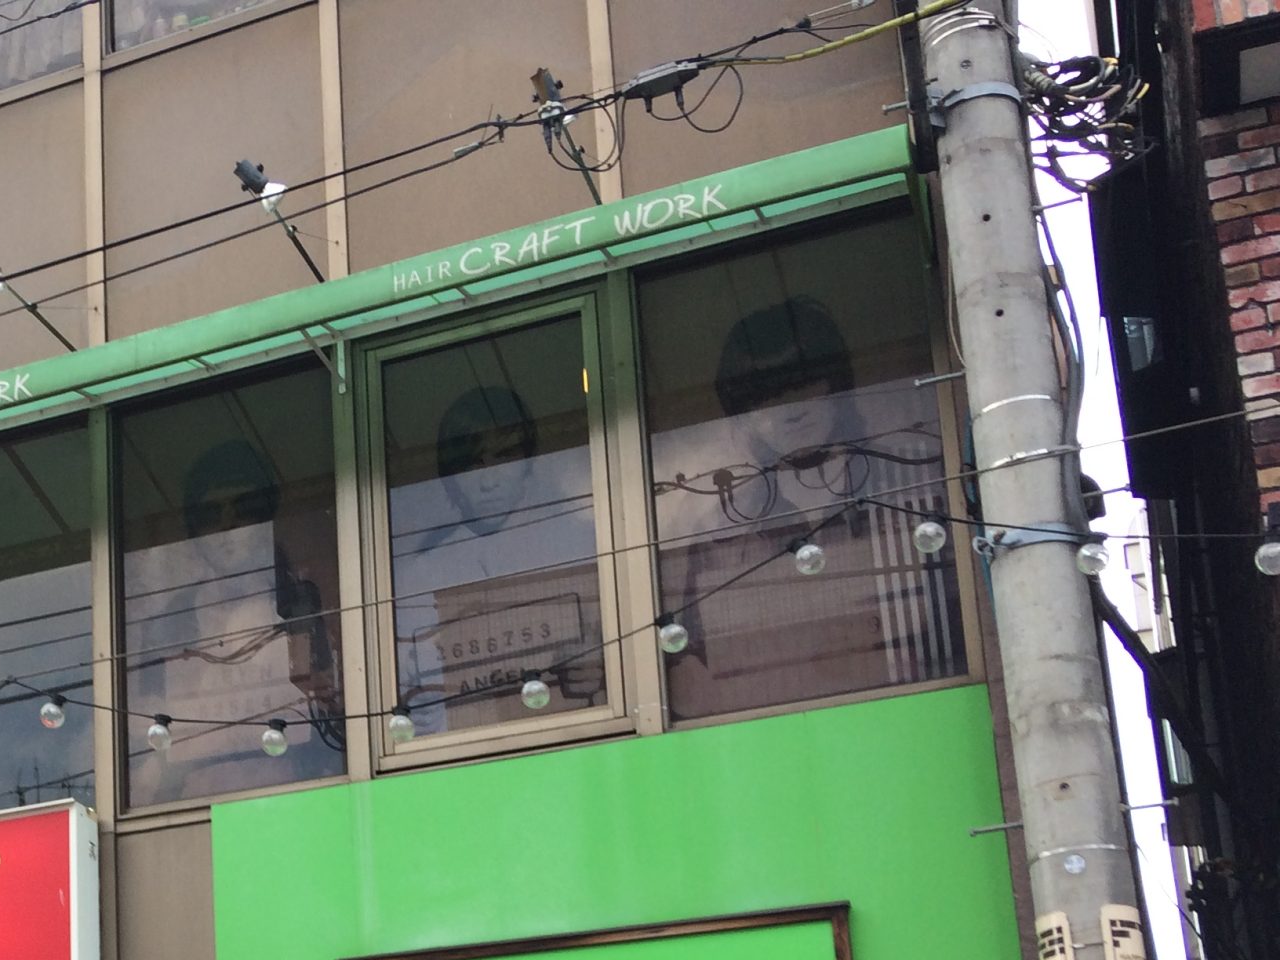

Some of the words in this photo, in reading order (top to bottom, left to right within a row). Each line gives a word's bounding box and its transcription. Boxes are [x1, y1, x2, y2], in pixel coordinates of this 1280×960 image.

[392, 260, 452, 293] HAIR
[459, 216, 595, 276] CRAFT
[613, 183, 727, 237] WORK
